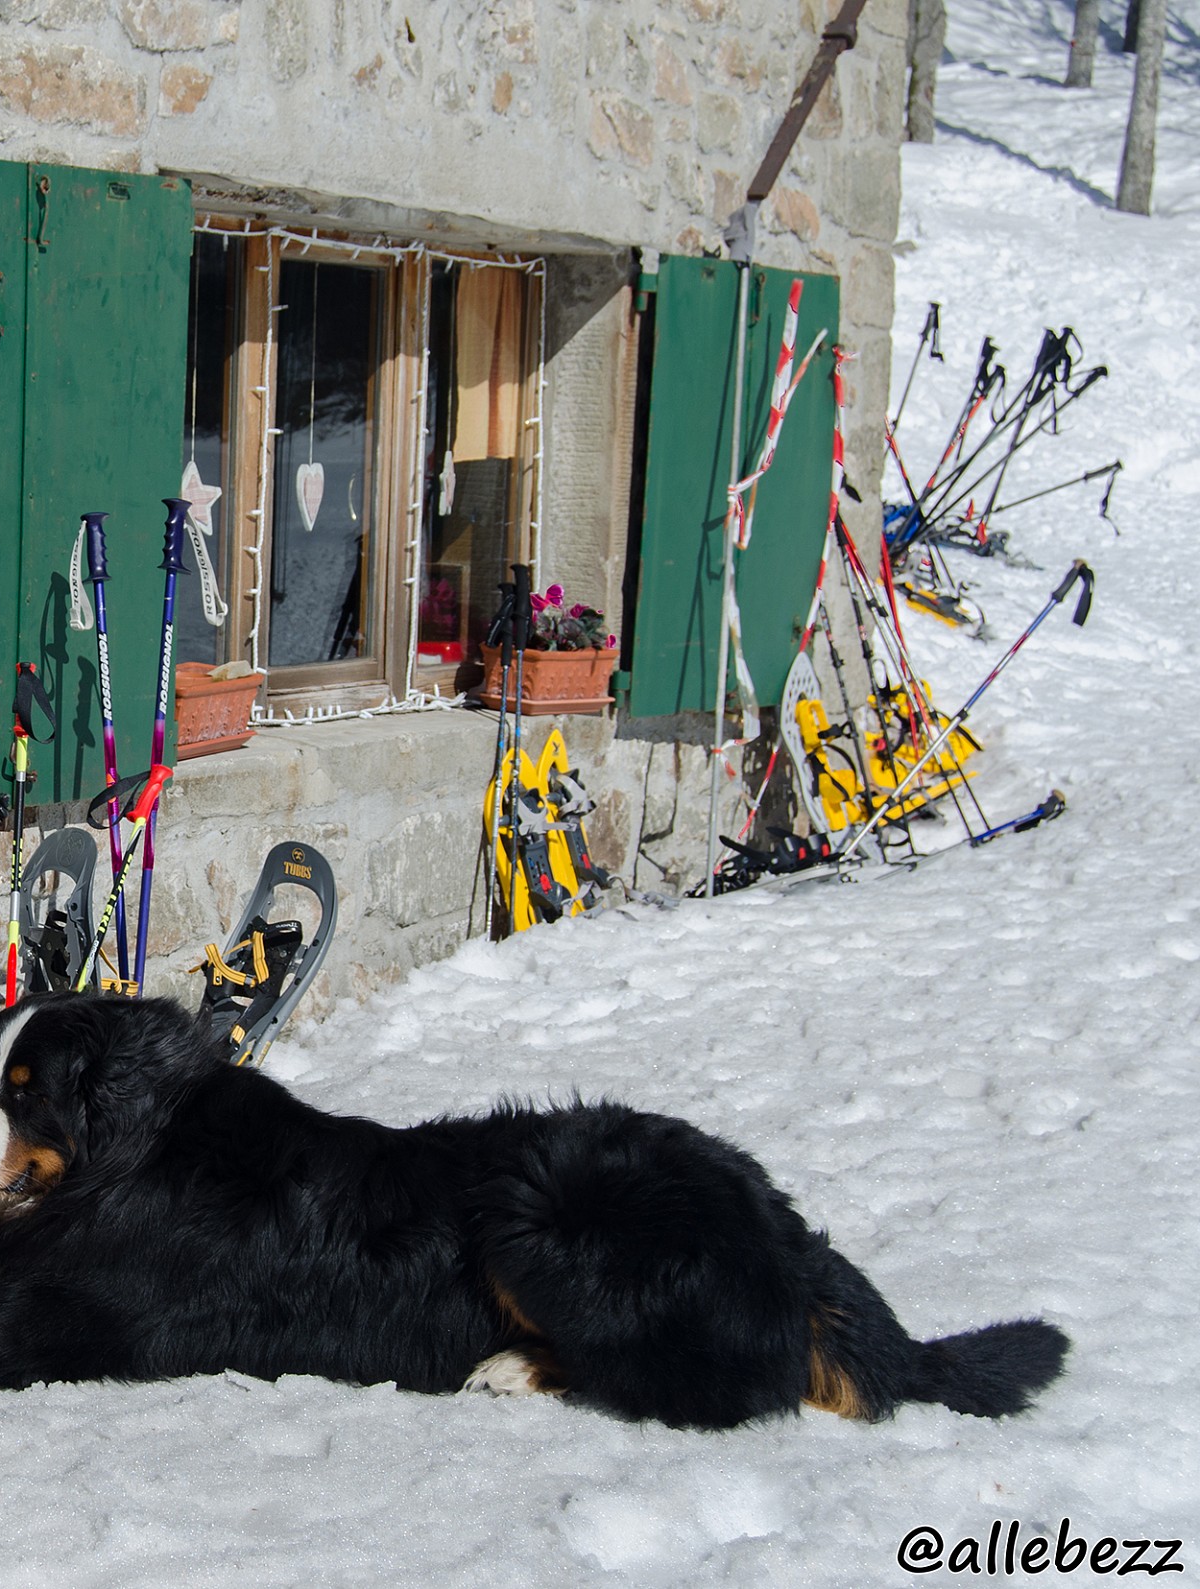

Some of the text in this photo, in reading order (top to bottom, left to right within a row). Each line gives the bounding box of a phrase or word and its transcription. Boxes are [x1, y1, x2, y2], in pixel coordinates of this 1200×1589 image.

[191, 529, 212, 615] ROSSIGNOL
[98, 632, 113, 721] ROSSIGNOL
[159, 623, 174, 715] ROSSIGNOL
[283, 861, 312, 881] TUBBS
